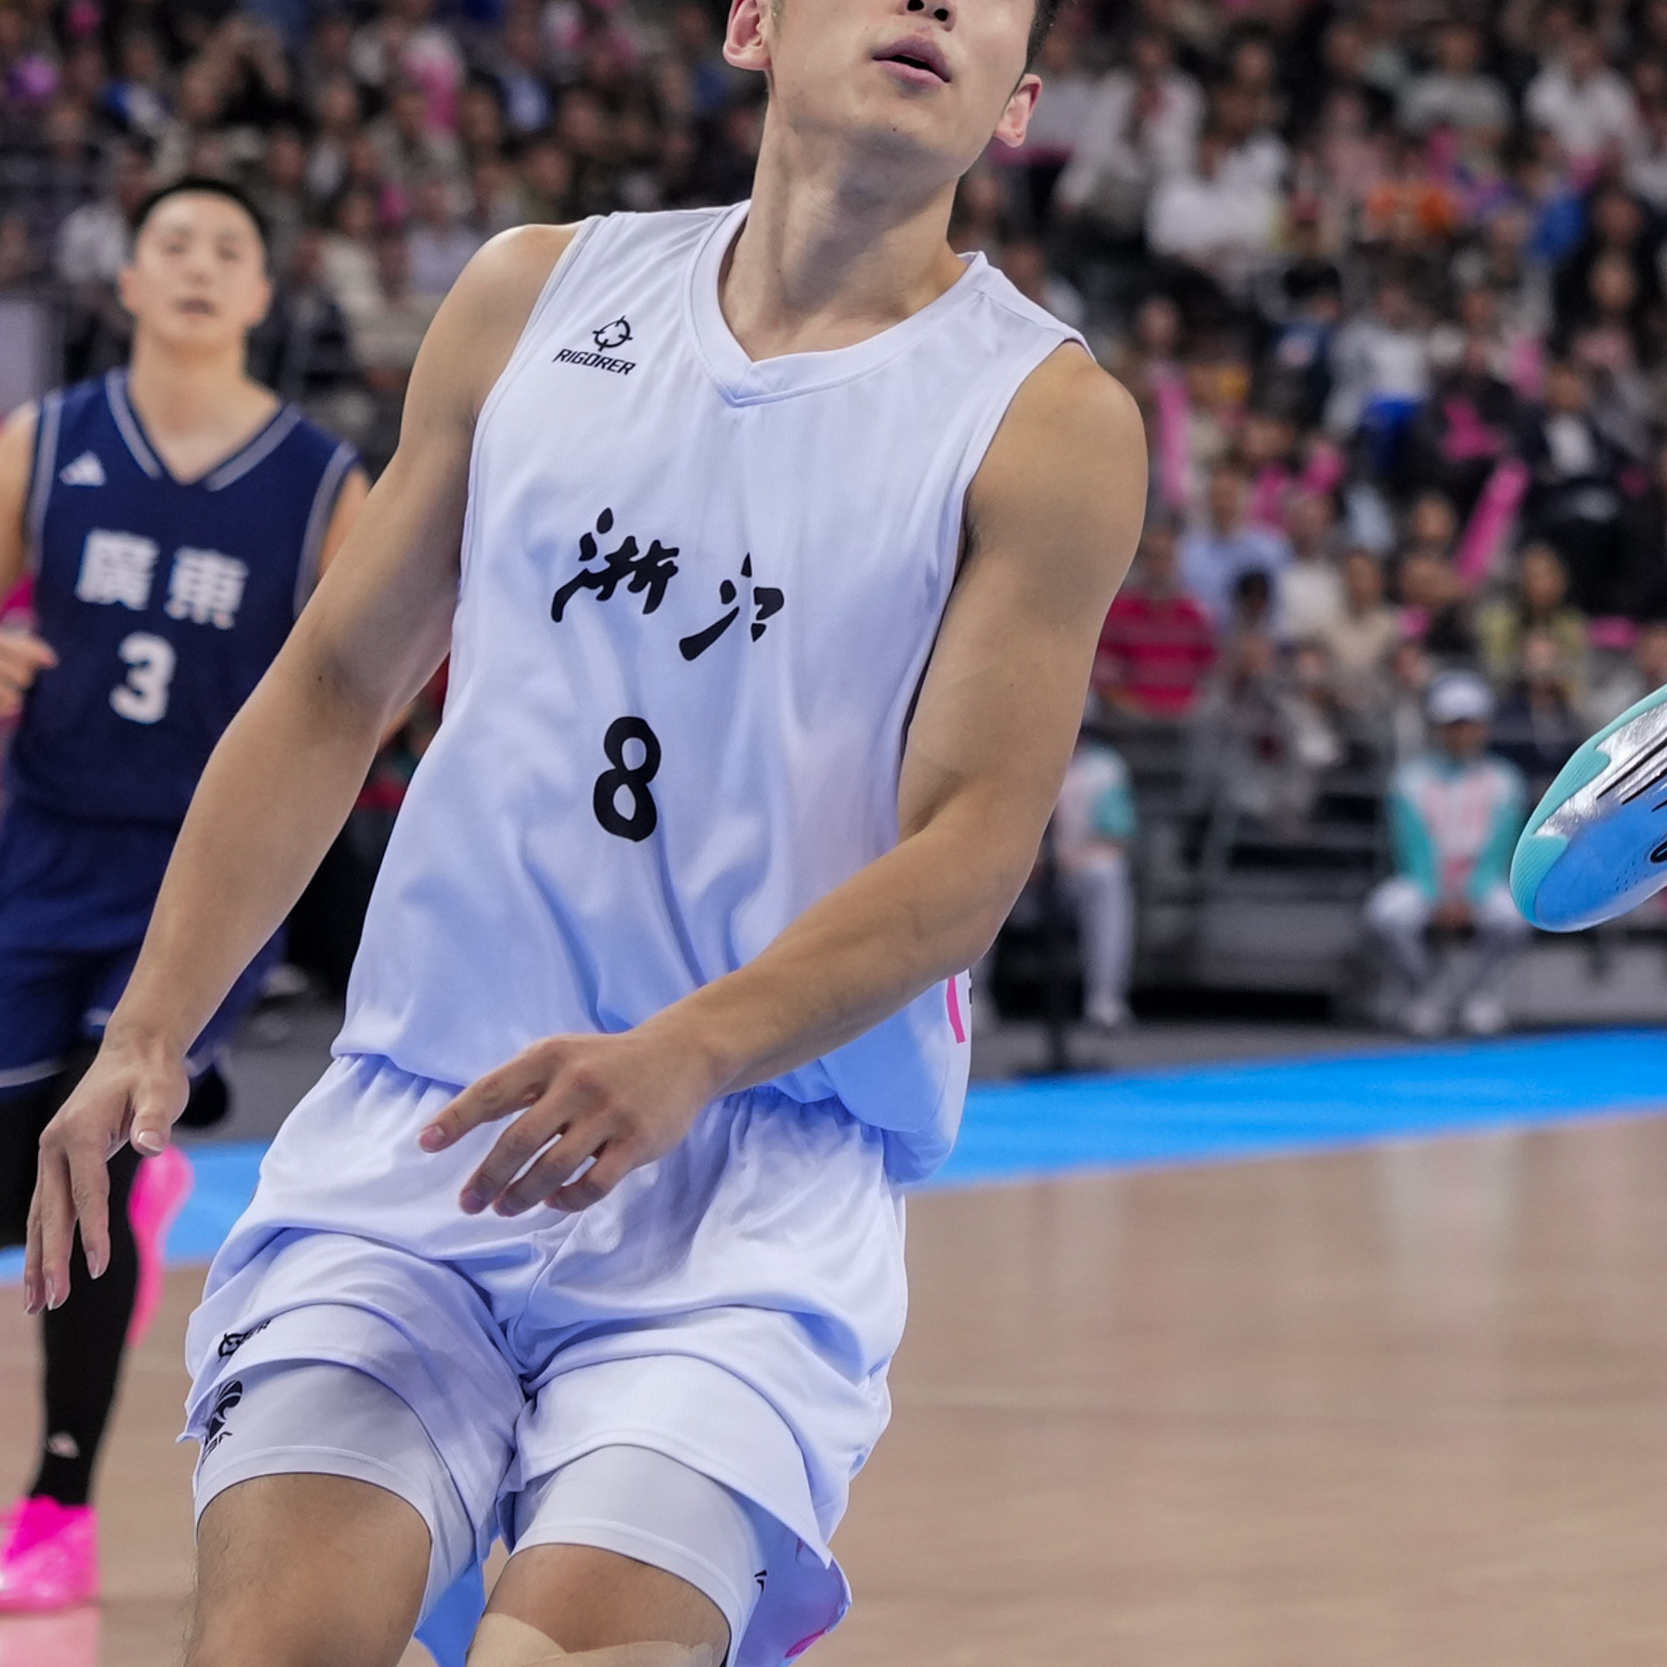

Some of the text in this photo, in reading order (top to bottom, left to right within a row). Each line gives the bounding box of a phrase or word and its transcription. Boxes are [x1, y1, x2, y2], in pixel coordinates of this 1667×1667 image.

[551, 348, 637, 376] RIGORER
[551, 507, 786, 661] 浙江
[109, 632, 178, 725] 3
[593, 716, 662, 842] 8
